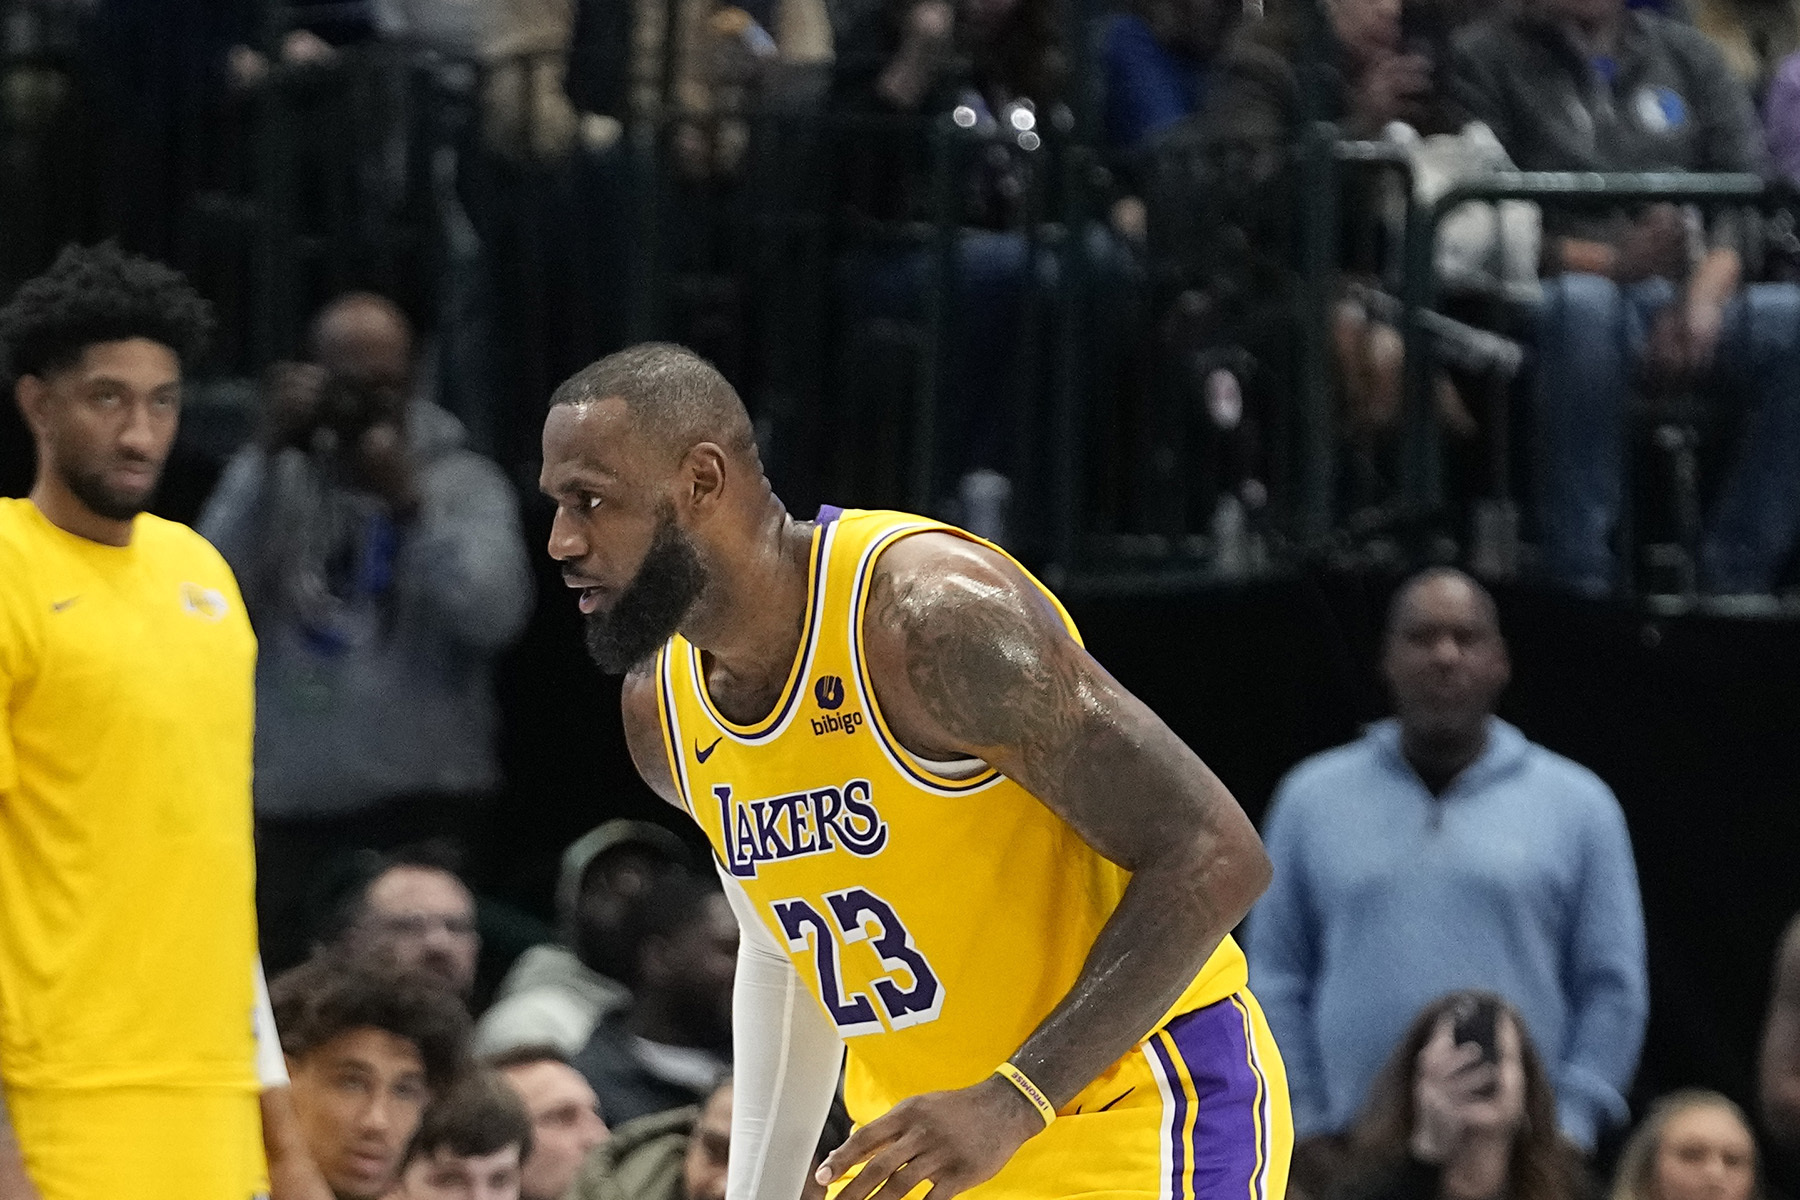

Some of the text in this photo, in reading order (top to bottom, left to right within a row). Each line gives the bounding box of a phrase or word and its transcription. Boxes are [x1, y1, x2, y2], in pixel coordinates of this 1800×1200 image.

[810, 711, 863, 736] bibigo
[711, 778, 889, 879] LAKERS
[769, 885, 946, 1038] 23
[1011, 1071, 1046, 1107] PROMISE
